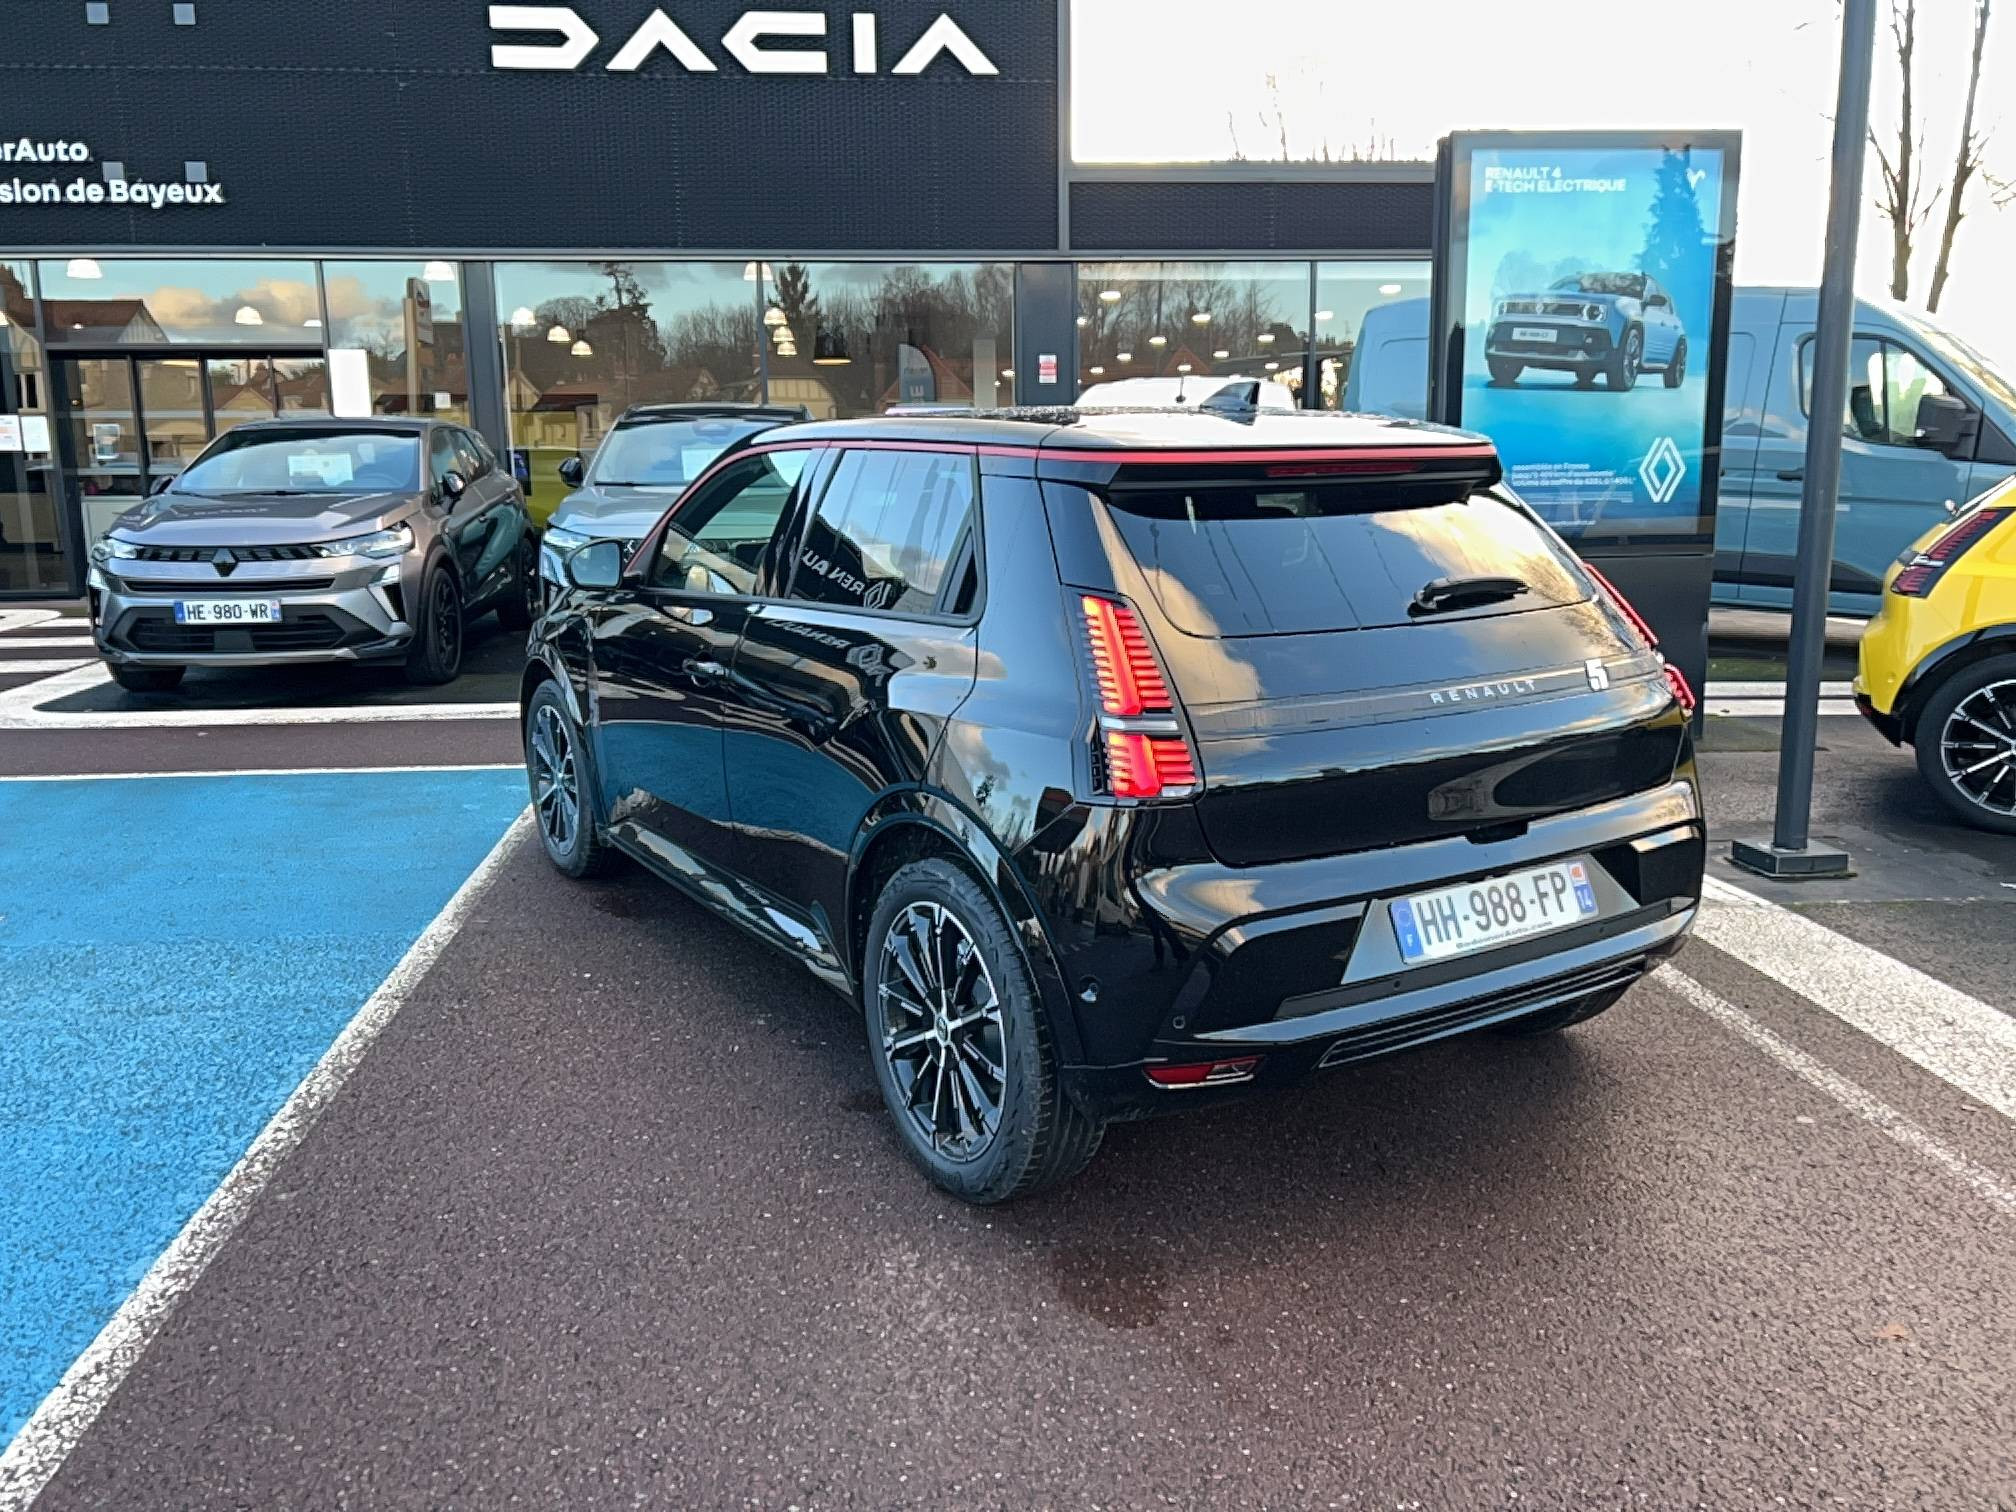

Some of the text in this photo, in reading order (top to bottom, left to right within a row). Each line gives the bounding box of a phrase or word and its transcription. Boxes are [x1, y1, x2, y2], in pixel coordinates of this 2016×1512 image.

[489, 4, 1000, 76] DACIA
[0, 138, 90, 162] rAuto
[1485, 166, 1562, 180] RENAULT 4
[65, 177, 104, 203] de
[108, 178, 224, 210] Bayeux
[186, 602, 269, 620] HE-980-WR
[1584, 659, 1609, 692] 5
[1430, 679, 1536, 705] RENAULT
[1416, 871, 1566, 946] HH-988-FP
